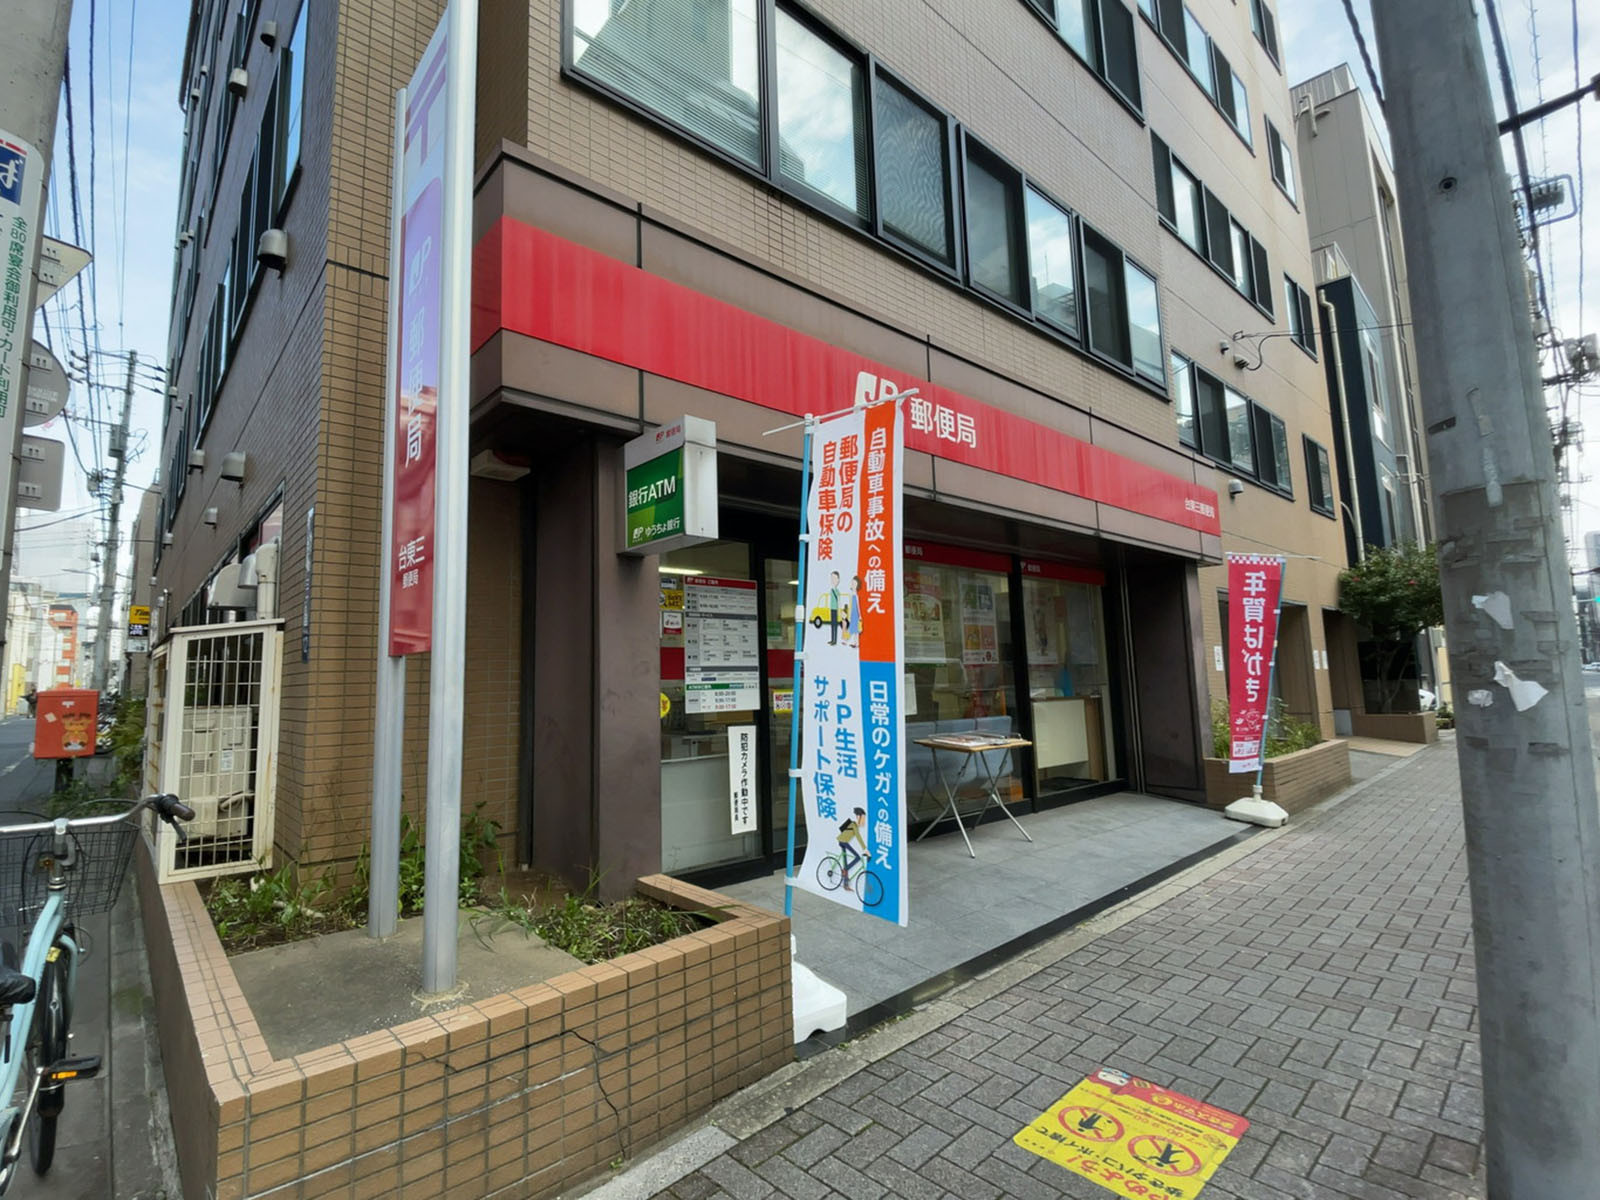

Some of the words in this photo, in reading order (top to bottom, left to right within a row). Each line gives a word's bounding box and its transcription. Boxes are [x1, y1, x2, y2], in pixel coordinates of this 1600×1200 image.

[910, 397, 977, 449] 郵便局
[628, 475, 676, 508] 銀行ATM
[645, 517, 680, 537] ゆうちょ銀行
[817, 440, 838, 562] 自動車保険
[836, 433, 859, 533] 郵便局の
[864, 427, 886, 615] 自動車事故への備え
[398, 535, 425, 571] 台東三
[740, 732, 749, 825] 防犯カメラ作動中です
[813, 674, 838, 822] サポート保険
[834, 678, 859, 780] JP生活
[868, 680, 893, 870] 日常のケガへの備え
